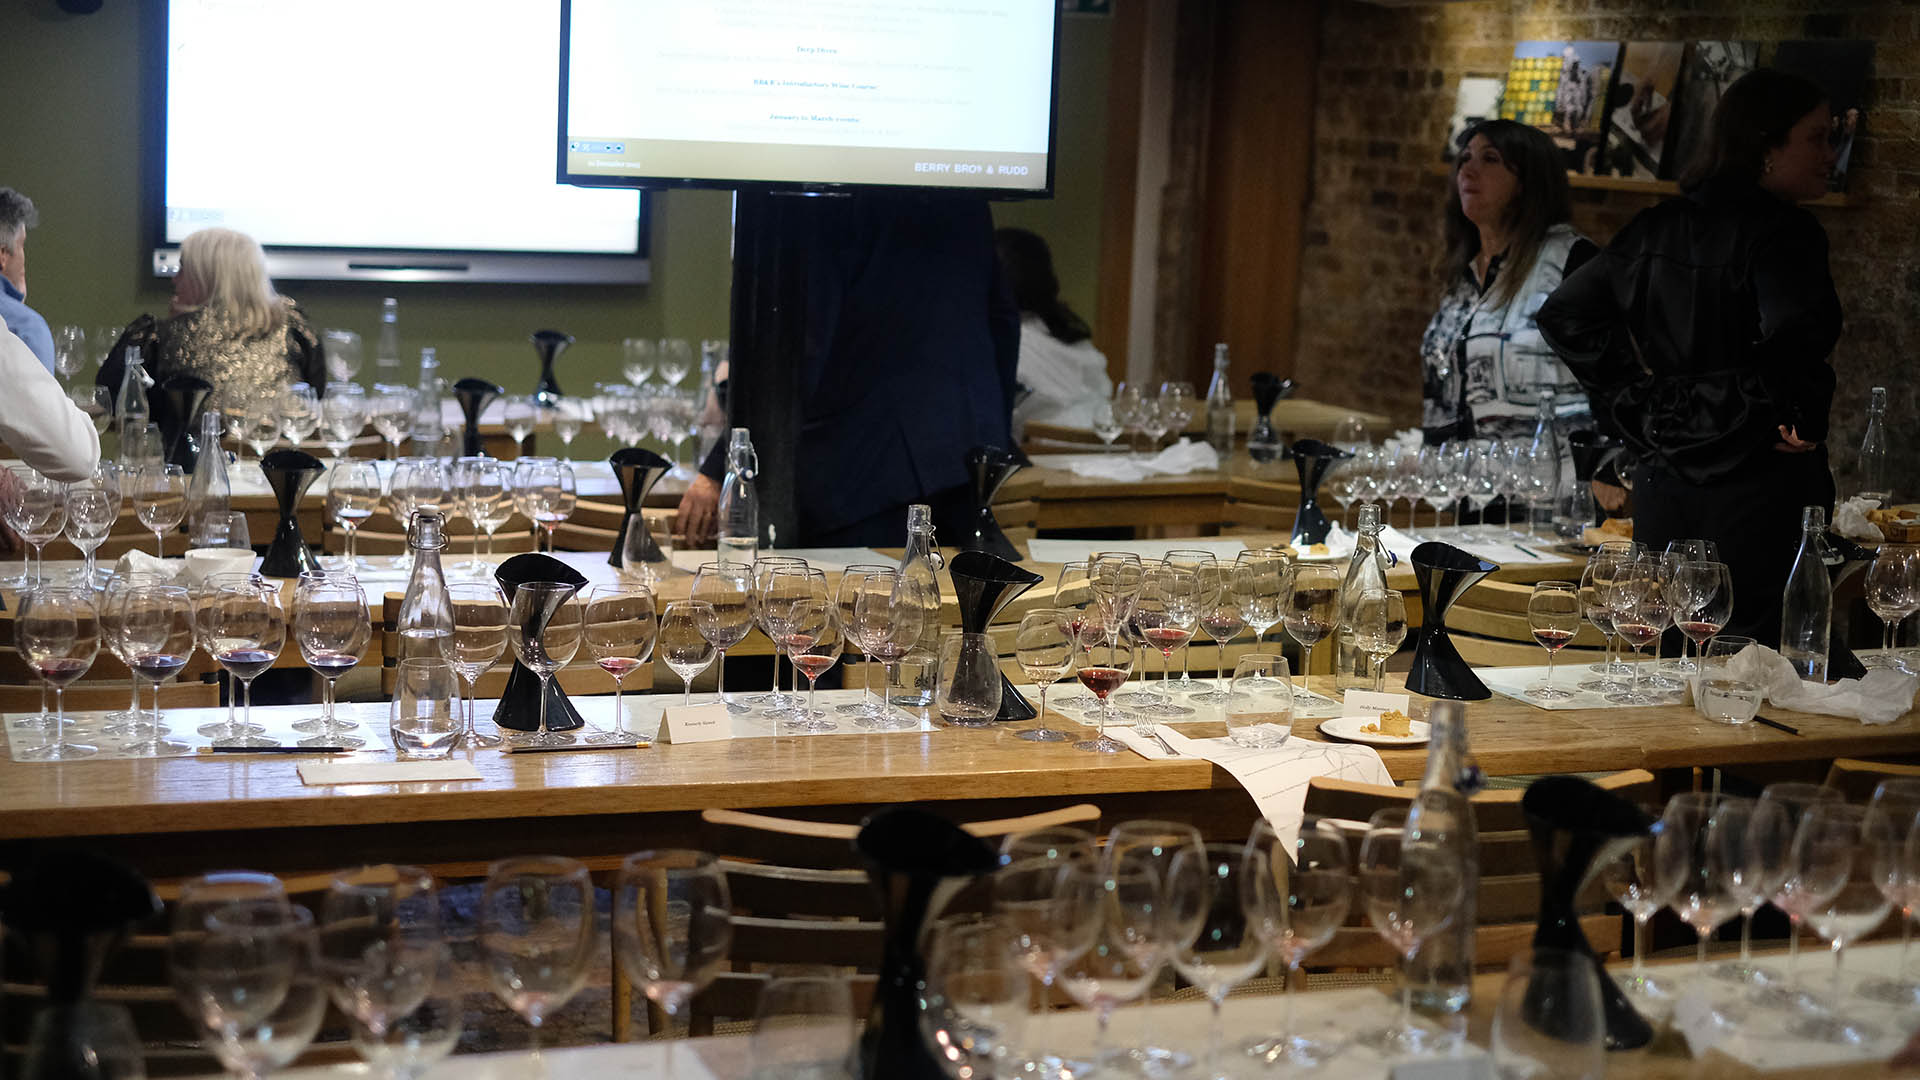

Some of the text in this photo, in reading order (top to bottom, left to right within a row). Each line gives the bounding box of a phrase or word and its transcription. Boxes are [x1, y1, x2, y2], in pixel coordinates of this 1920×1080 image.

[914, 162, 951, 174] BERRY
[986, 164, 995, 175] &
[998, 165, 1029, 176] RUDD
